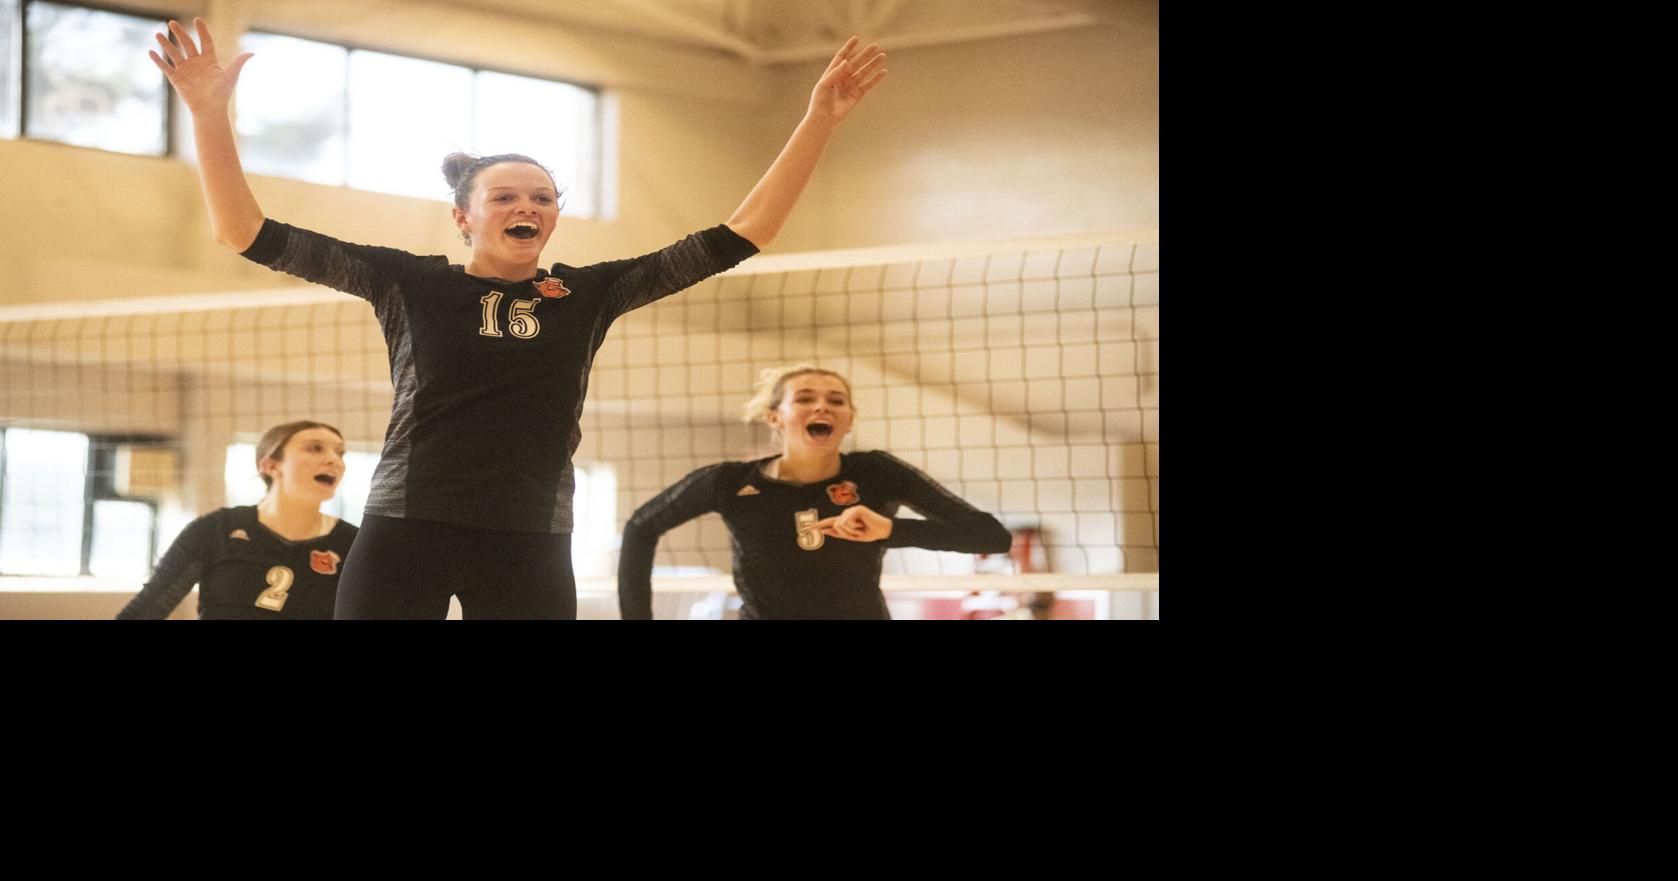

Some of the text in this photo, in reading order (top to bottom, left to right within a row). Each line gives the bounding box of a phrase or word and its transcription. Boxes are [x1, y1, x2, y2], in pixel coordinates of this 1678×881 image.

[479, 290, 541, 339] 15
[794, 508, 825, 550] 5
[254, 565, 294, 612] 2
